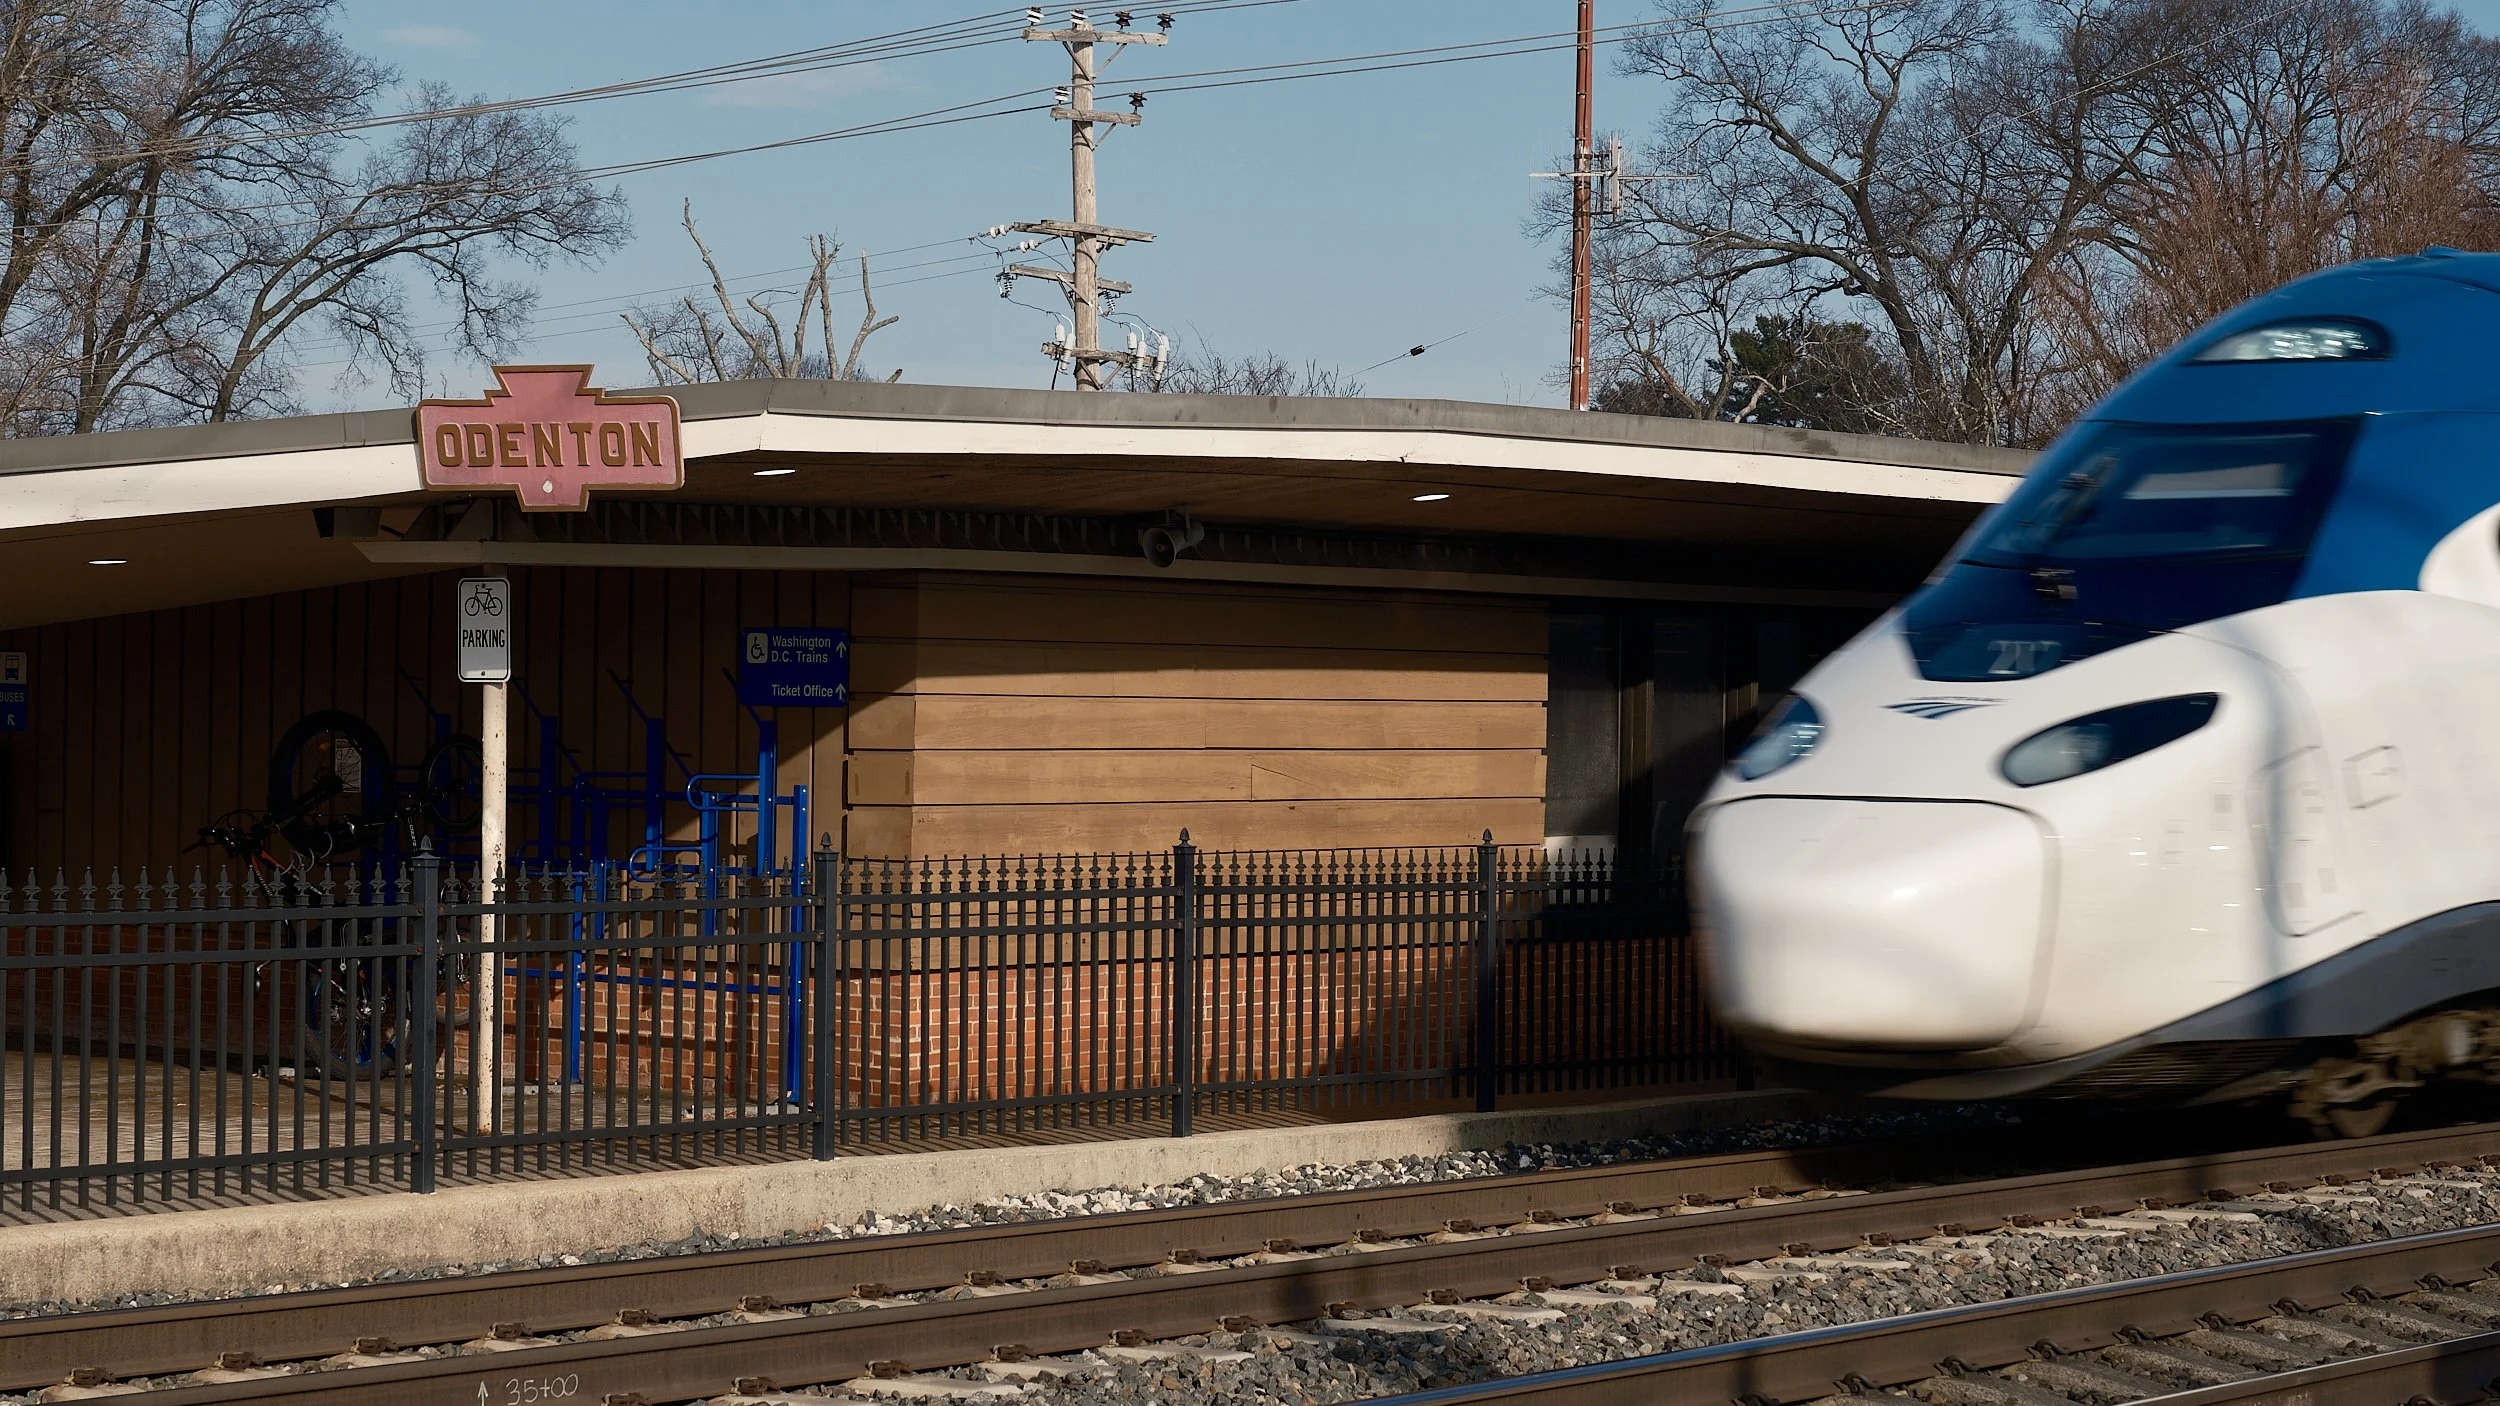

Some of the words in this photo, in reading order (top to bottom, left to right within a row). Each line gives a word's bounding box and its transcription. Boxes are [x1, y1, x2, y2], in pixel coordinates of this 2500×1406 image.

[435, 422, 662, 467] ODENTON
[462, 629, 506, 648] PARKING
[772, 635, 831, 650] Washington
[771, 650, 793, 663] D.C.
[796, 650, 828, 663] Trains
[771, 684, 801, 697] Ticket
[803, 684, 834, 697] Office
[505, 1373, 579, 1406] 35+00
